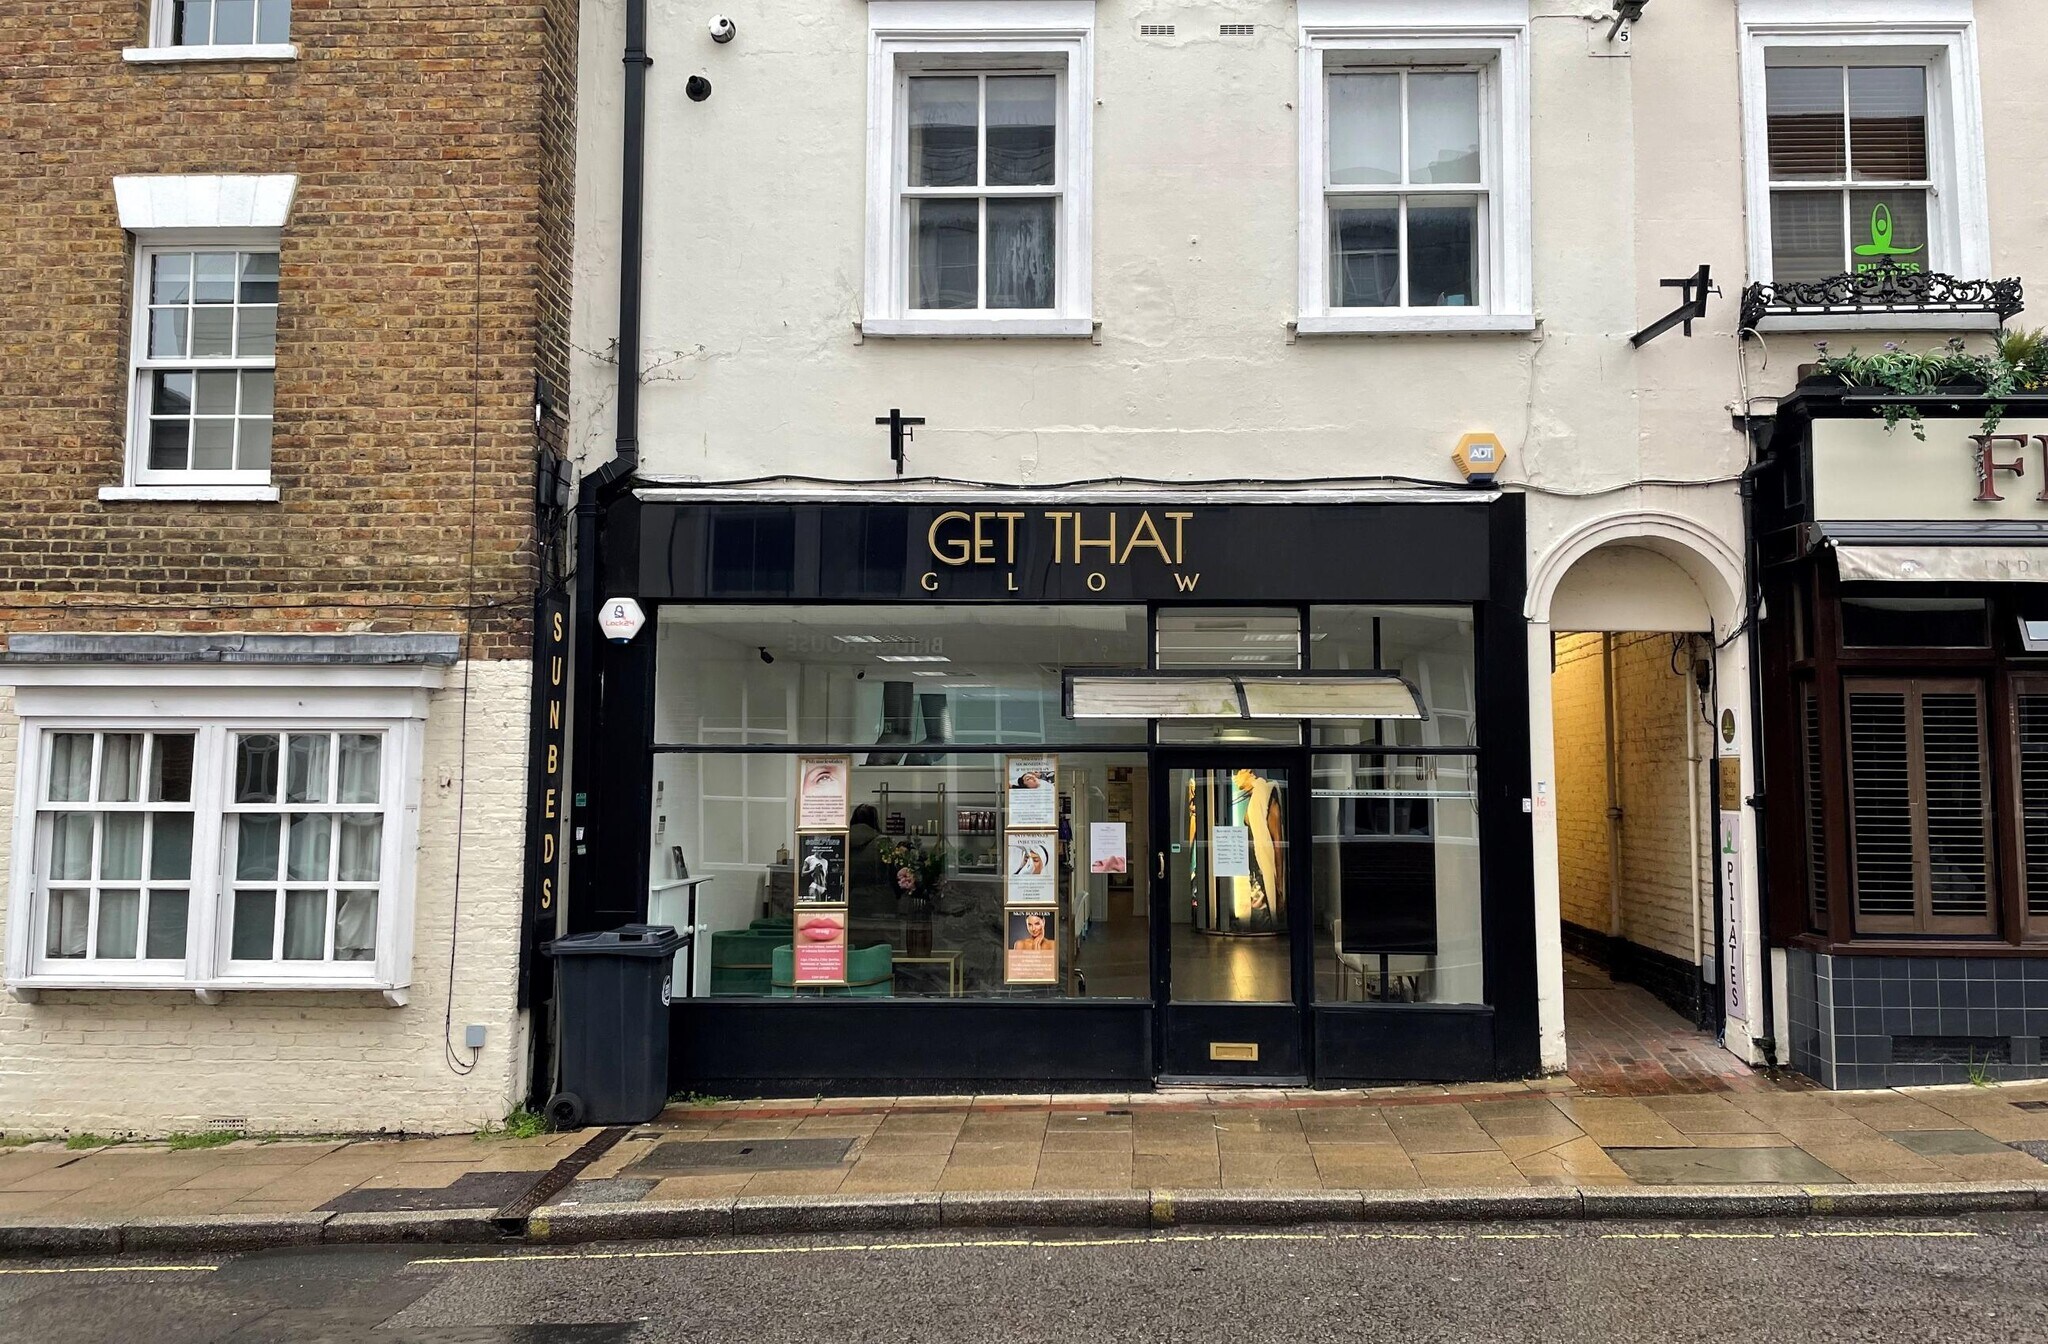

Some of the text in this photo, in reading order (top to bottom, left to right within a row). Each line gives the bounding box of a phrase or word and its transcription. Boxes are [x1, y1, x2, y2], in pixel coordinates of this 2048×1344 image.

[1620, 31, 1629, 42] 5
[1470, 447, 1494, 459] ADT
[927, 510, 1194, 566] GET THAT
[541, 612, 563, 909] SUNBEDS
[1536, 797, 1547, 807] 16
[1727, 861, 1739, 1008] PILATES
